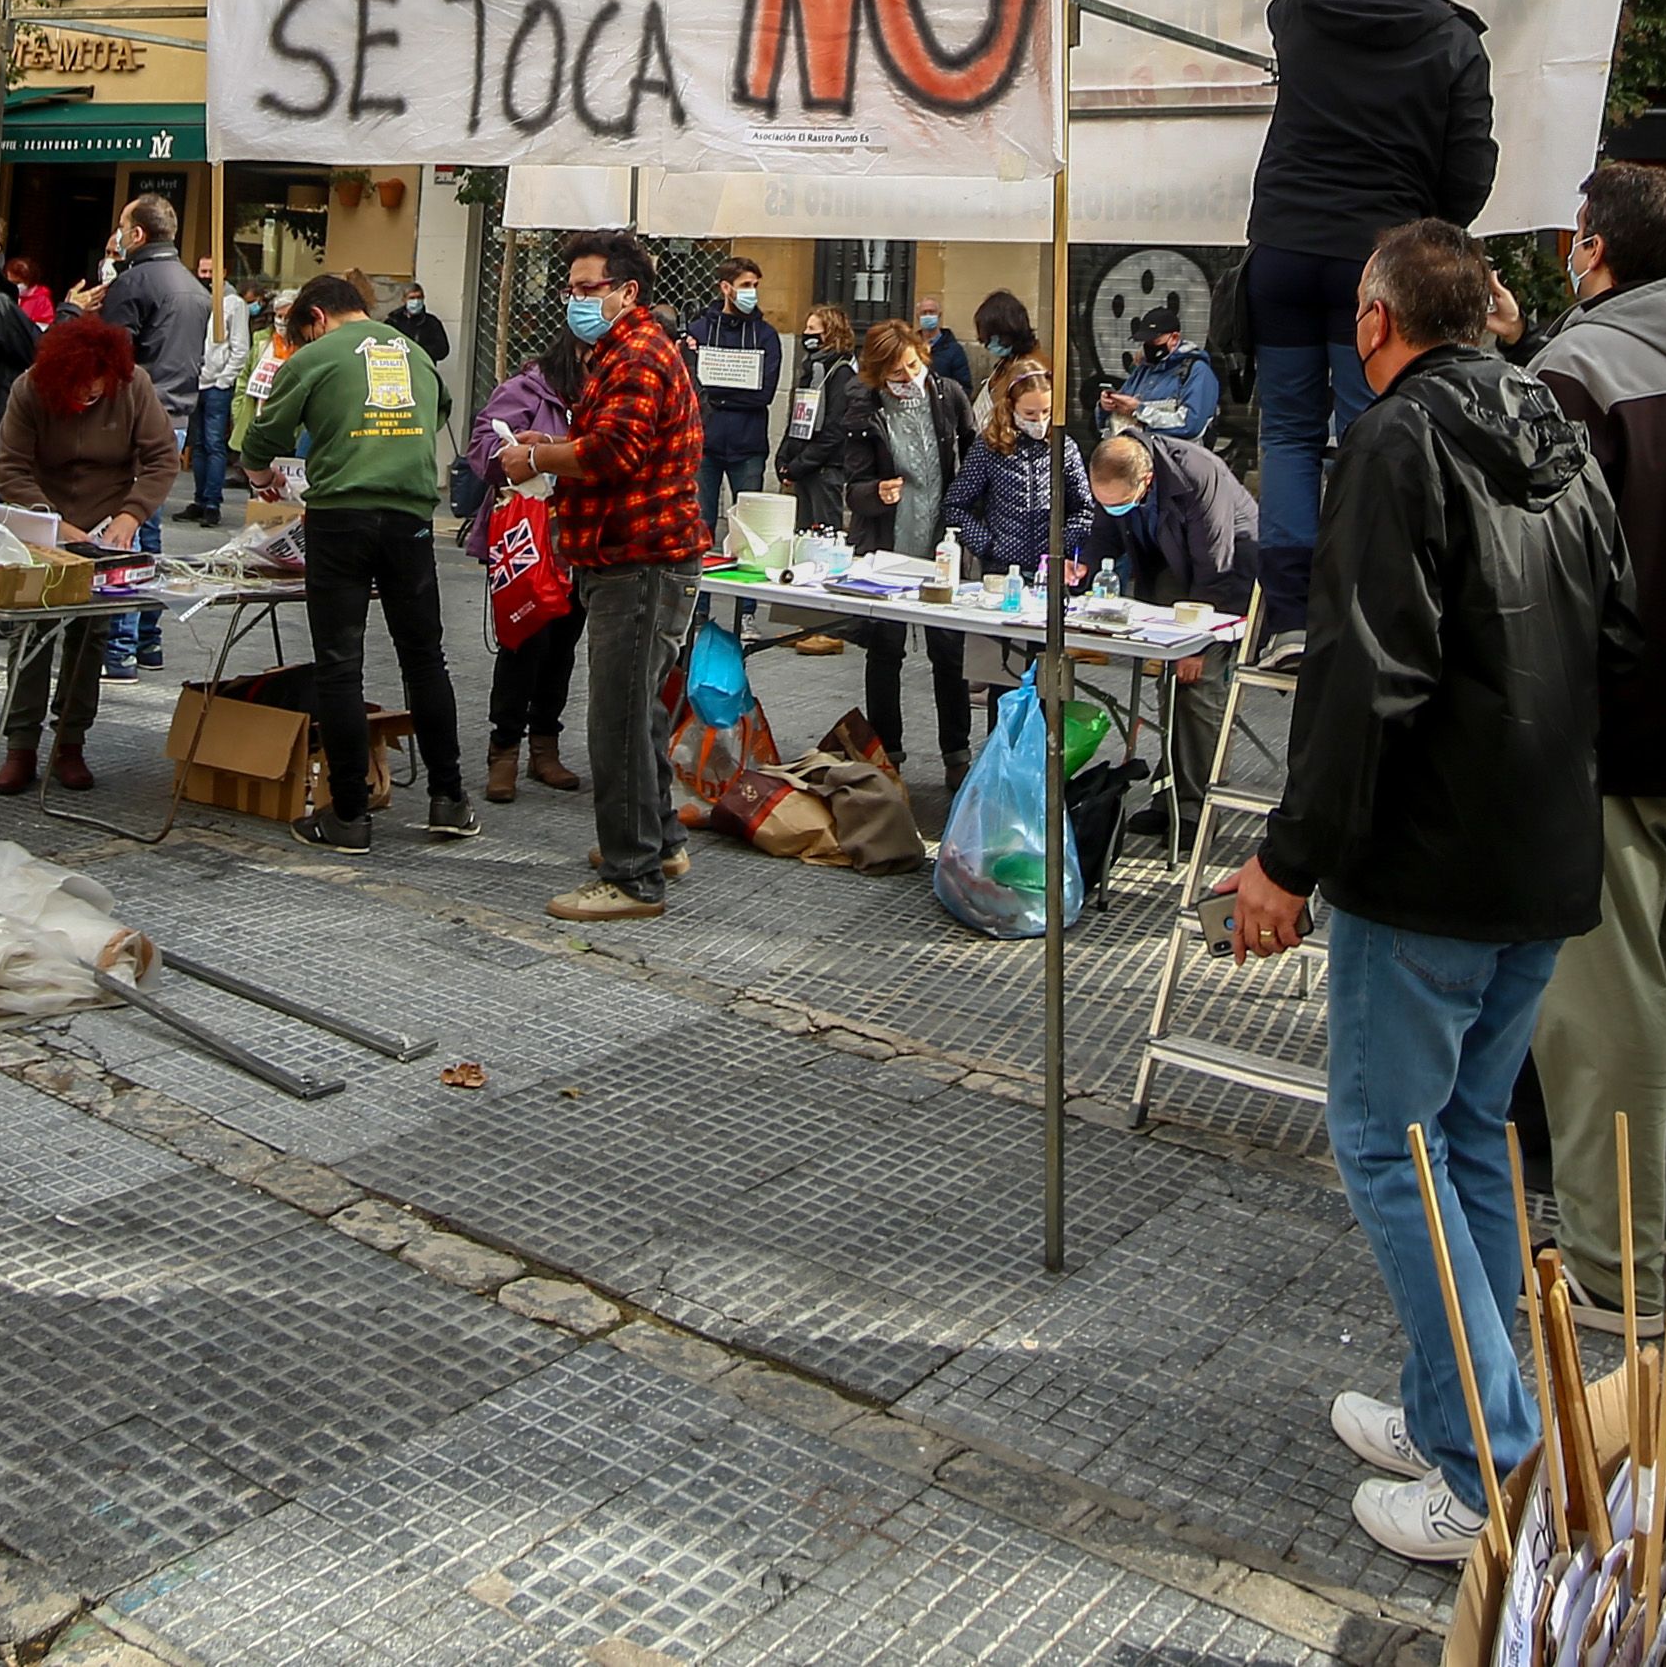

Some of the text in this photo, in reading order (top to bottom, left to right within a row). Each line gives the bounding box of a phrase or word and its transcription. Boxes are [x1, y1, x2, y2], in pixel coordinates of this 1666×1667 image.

[752, 132, 870, 143] Asociación El Rastro Punto Es
[24, 139, 79, 151] DESAYUNOS
[86, 138, 142, 150] BRUNCH
